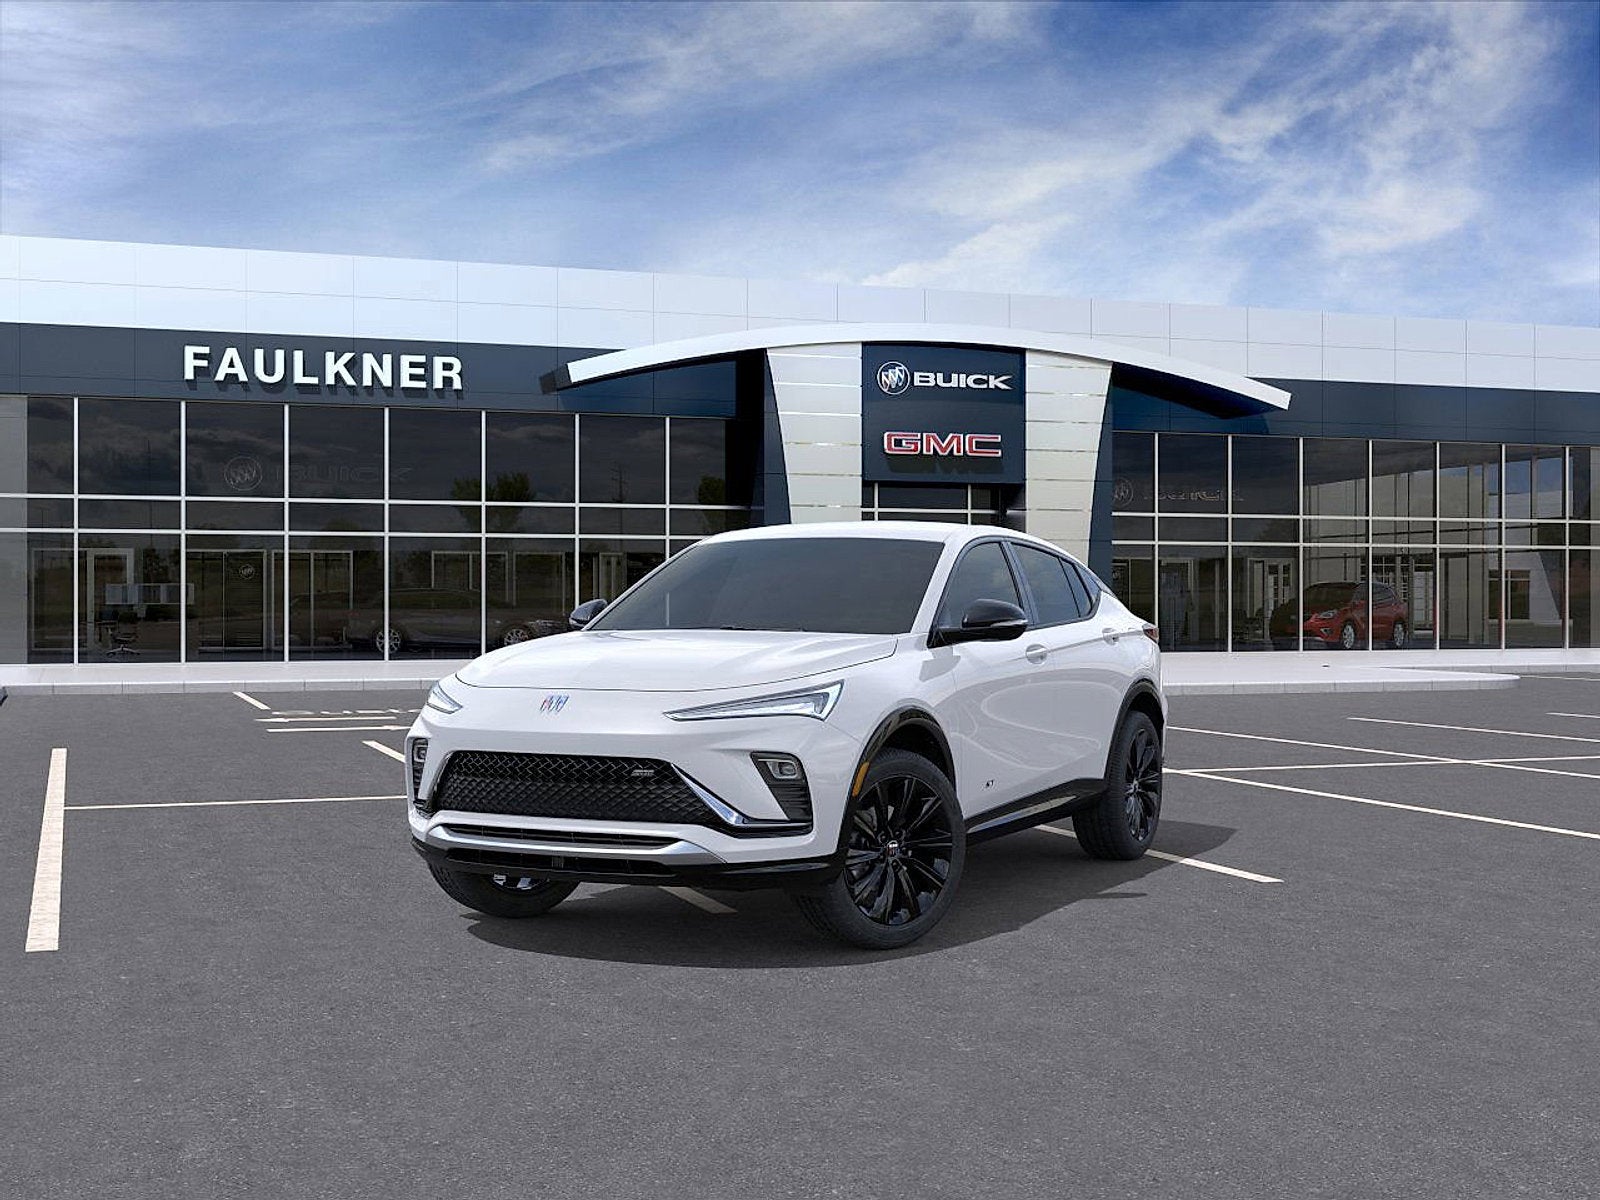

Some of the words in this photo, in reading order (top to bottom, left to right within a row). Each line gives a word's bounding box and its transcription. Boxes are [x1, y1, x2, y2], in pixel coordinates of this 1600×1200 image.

[184, 345, 463, 390] FAULKNER
[912, 371, 1013, 390] BUICK
[883, 431, 1002, 457] GMC
